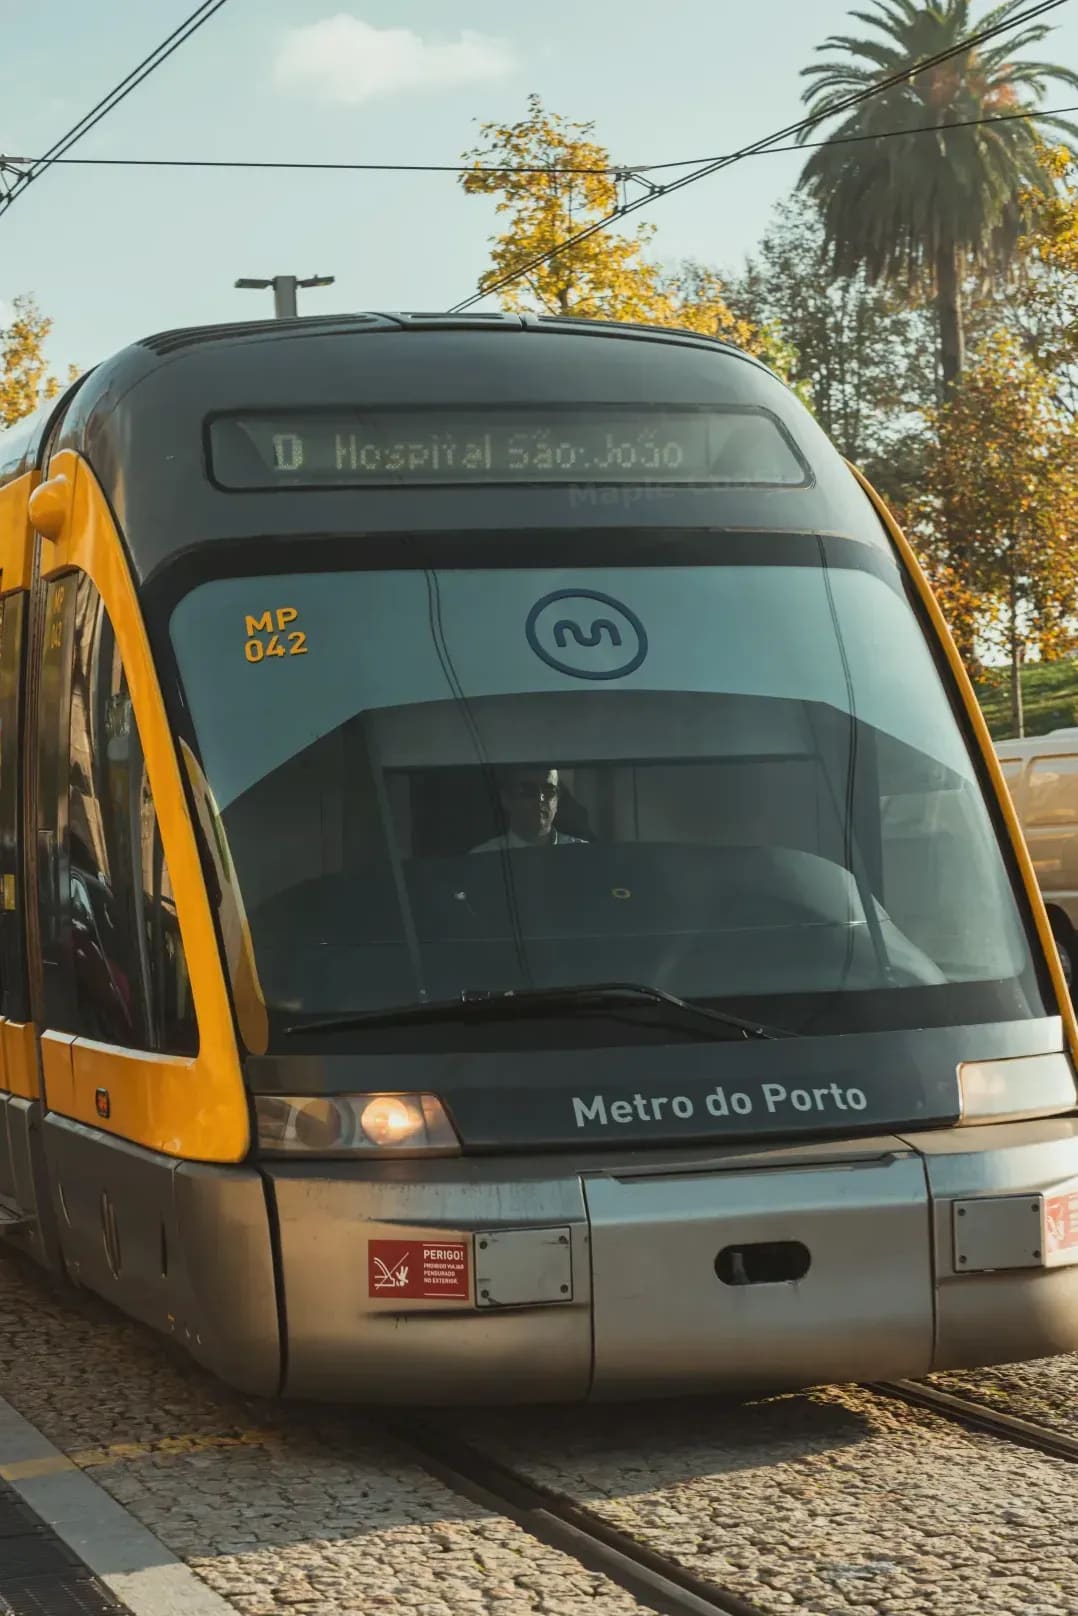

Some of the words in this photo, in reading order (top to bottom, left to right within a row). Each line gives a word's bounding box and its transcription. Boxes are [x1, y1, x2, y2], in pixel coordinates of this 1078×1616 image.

[273, 434, 304, 471] D
[335, 431, 492, 470] Hospital
[244, 607, 298, 637] MP
[244, 631, 308, 662] 042
[572, 1093, 694, 1127] Metro
[706, 1086, 752, 1116] do
[761, 1083, 867, 1113] Porto
[423, 1249, 464, 1261] PERIGO!
